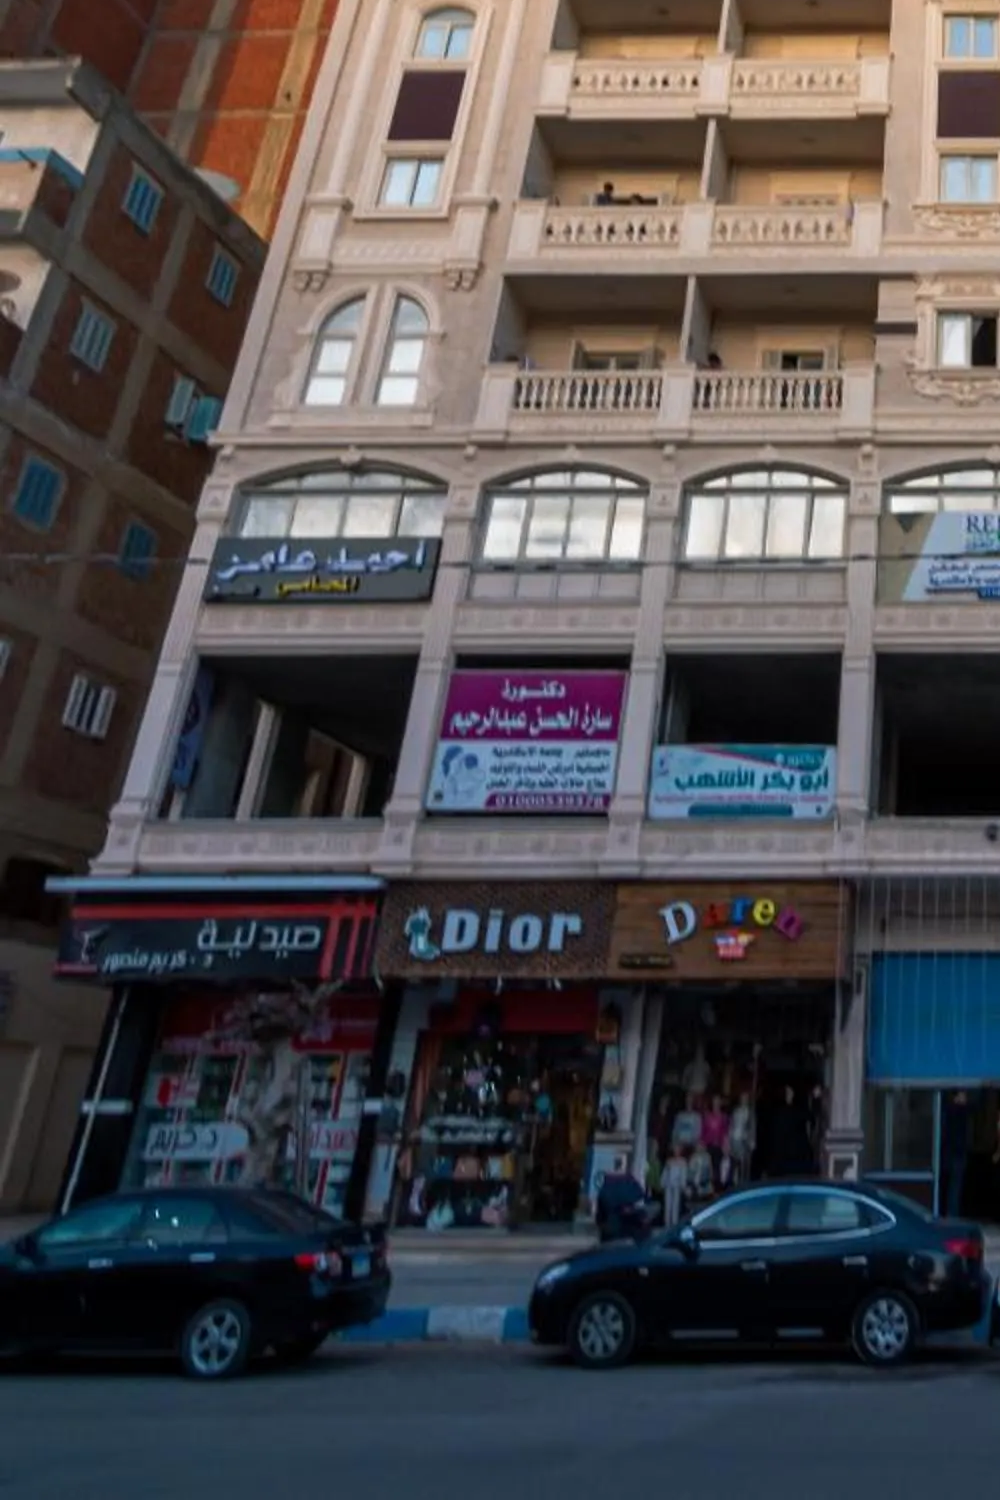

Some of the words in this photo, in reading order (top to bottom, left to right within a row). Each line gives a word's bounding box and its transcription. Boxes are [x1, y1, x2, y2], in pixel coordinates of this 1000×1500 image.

[197, 918, 321, 959] صيدلية
[442, 908, 583, 953] Dior
[658, 897, 805, 945] Daren
[149, 950, 188, 974] كريم
